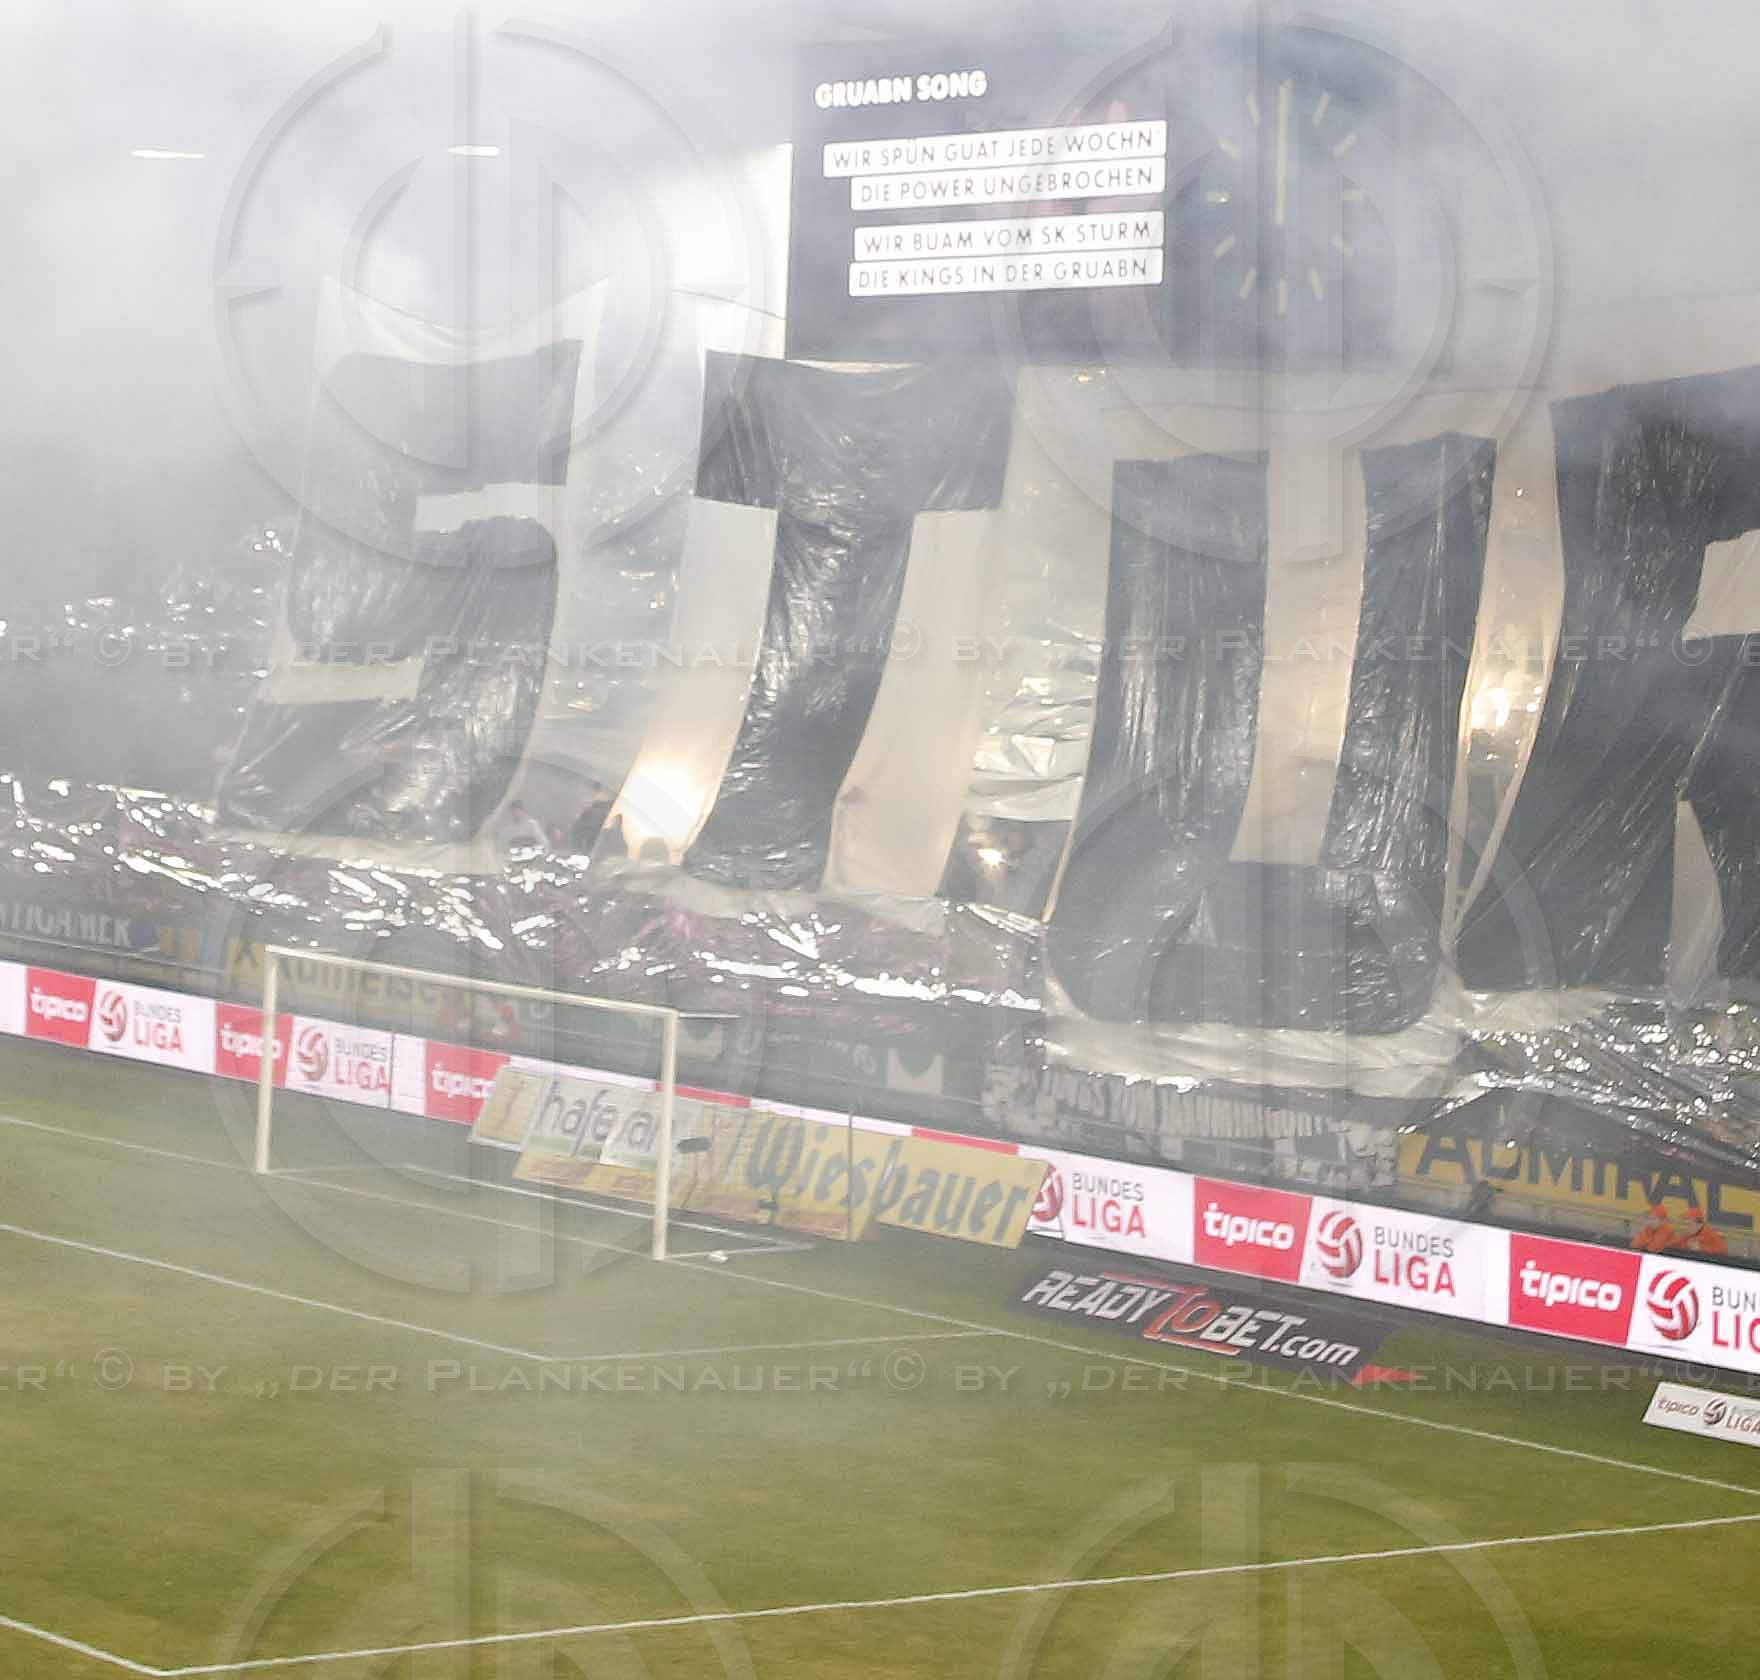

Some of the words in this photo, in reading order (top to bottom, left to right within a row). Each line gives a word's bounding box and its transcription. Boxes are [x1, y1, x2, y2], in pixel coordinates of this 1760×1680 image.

[815, 76, 912, 109] GRUABN
[917, 69, 987, 100] SONG
[832, 149, 872, 169] WIR
[944, 139, 999, 162] GUAT
[1008, 136, 1055, 158] JEDE
[1065, 128, 1152, 152] WOCHN
[861, 183, 891, 203] DIE
[899, 178, 975, 200] POWER
[983, 168, 1152, 197] UNGEBROCHEN
[863, 233, 903, 254] WIR
[913, 230, 973, 252] BUAM
[983, 227, 1032, 248] VOM
[1041, 225, 1065, 245] SK
[1076, 220, 1153, 243] STURM
[859, 269, 889, 289] DIE
[898, 265, 964, 288] KINGS
[973, 263, 995, 284] IN
[1005, 262, 1043, 283] DER
[1053, 257, 1147, 281] GRUABN
[133, 1021, 185, 1054] LIGA
[743, 1116, 1032, 1242] Wiesbauer
[1072, 1173, 1145, 1201] BUNDES
[1072, 1194, 1147, 1239] LIGA
[1204, 1202, 1296, 1250] tipico
[1374, 1226, 1456, 1259] BUNDES
[1373, 1248, 1457, 1298] LIGA
[1520, 1260, 1623, 1312] tipico
